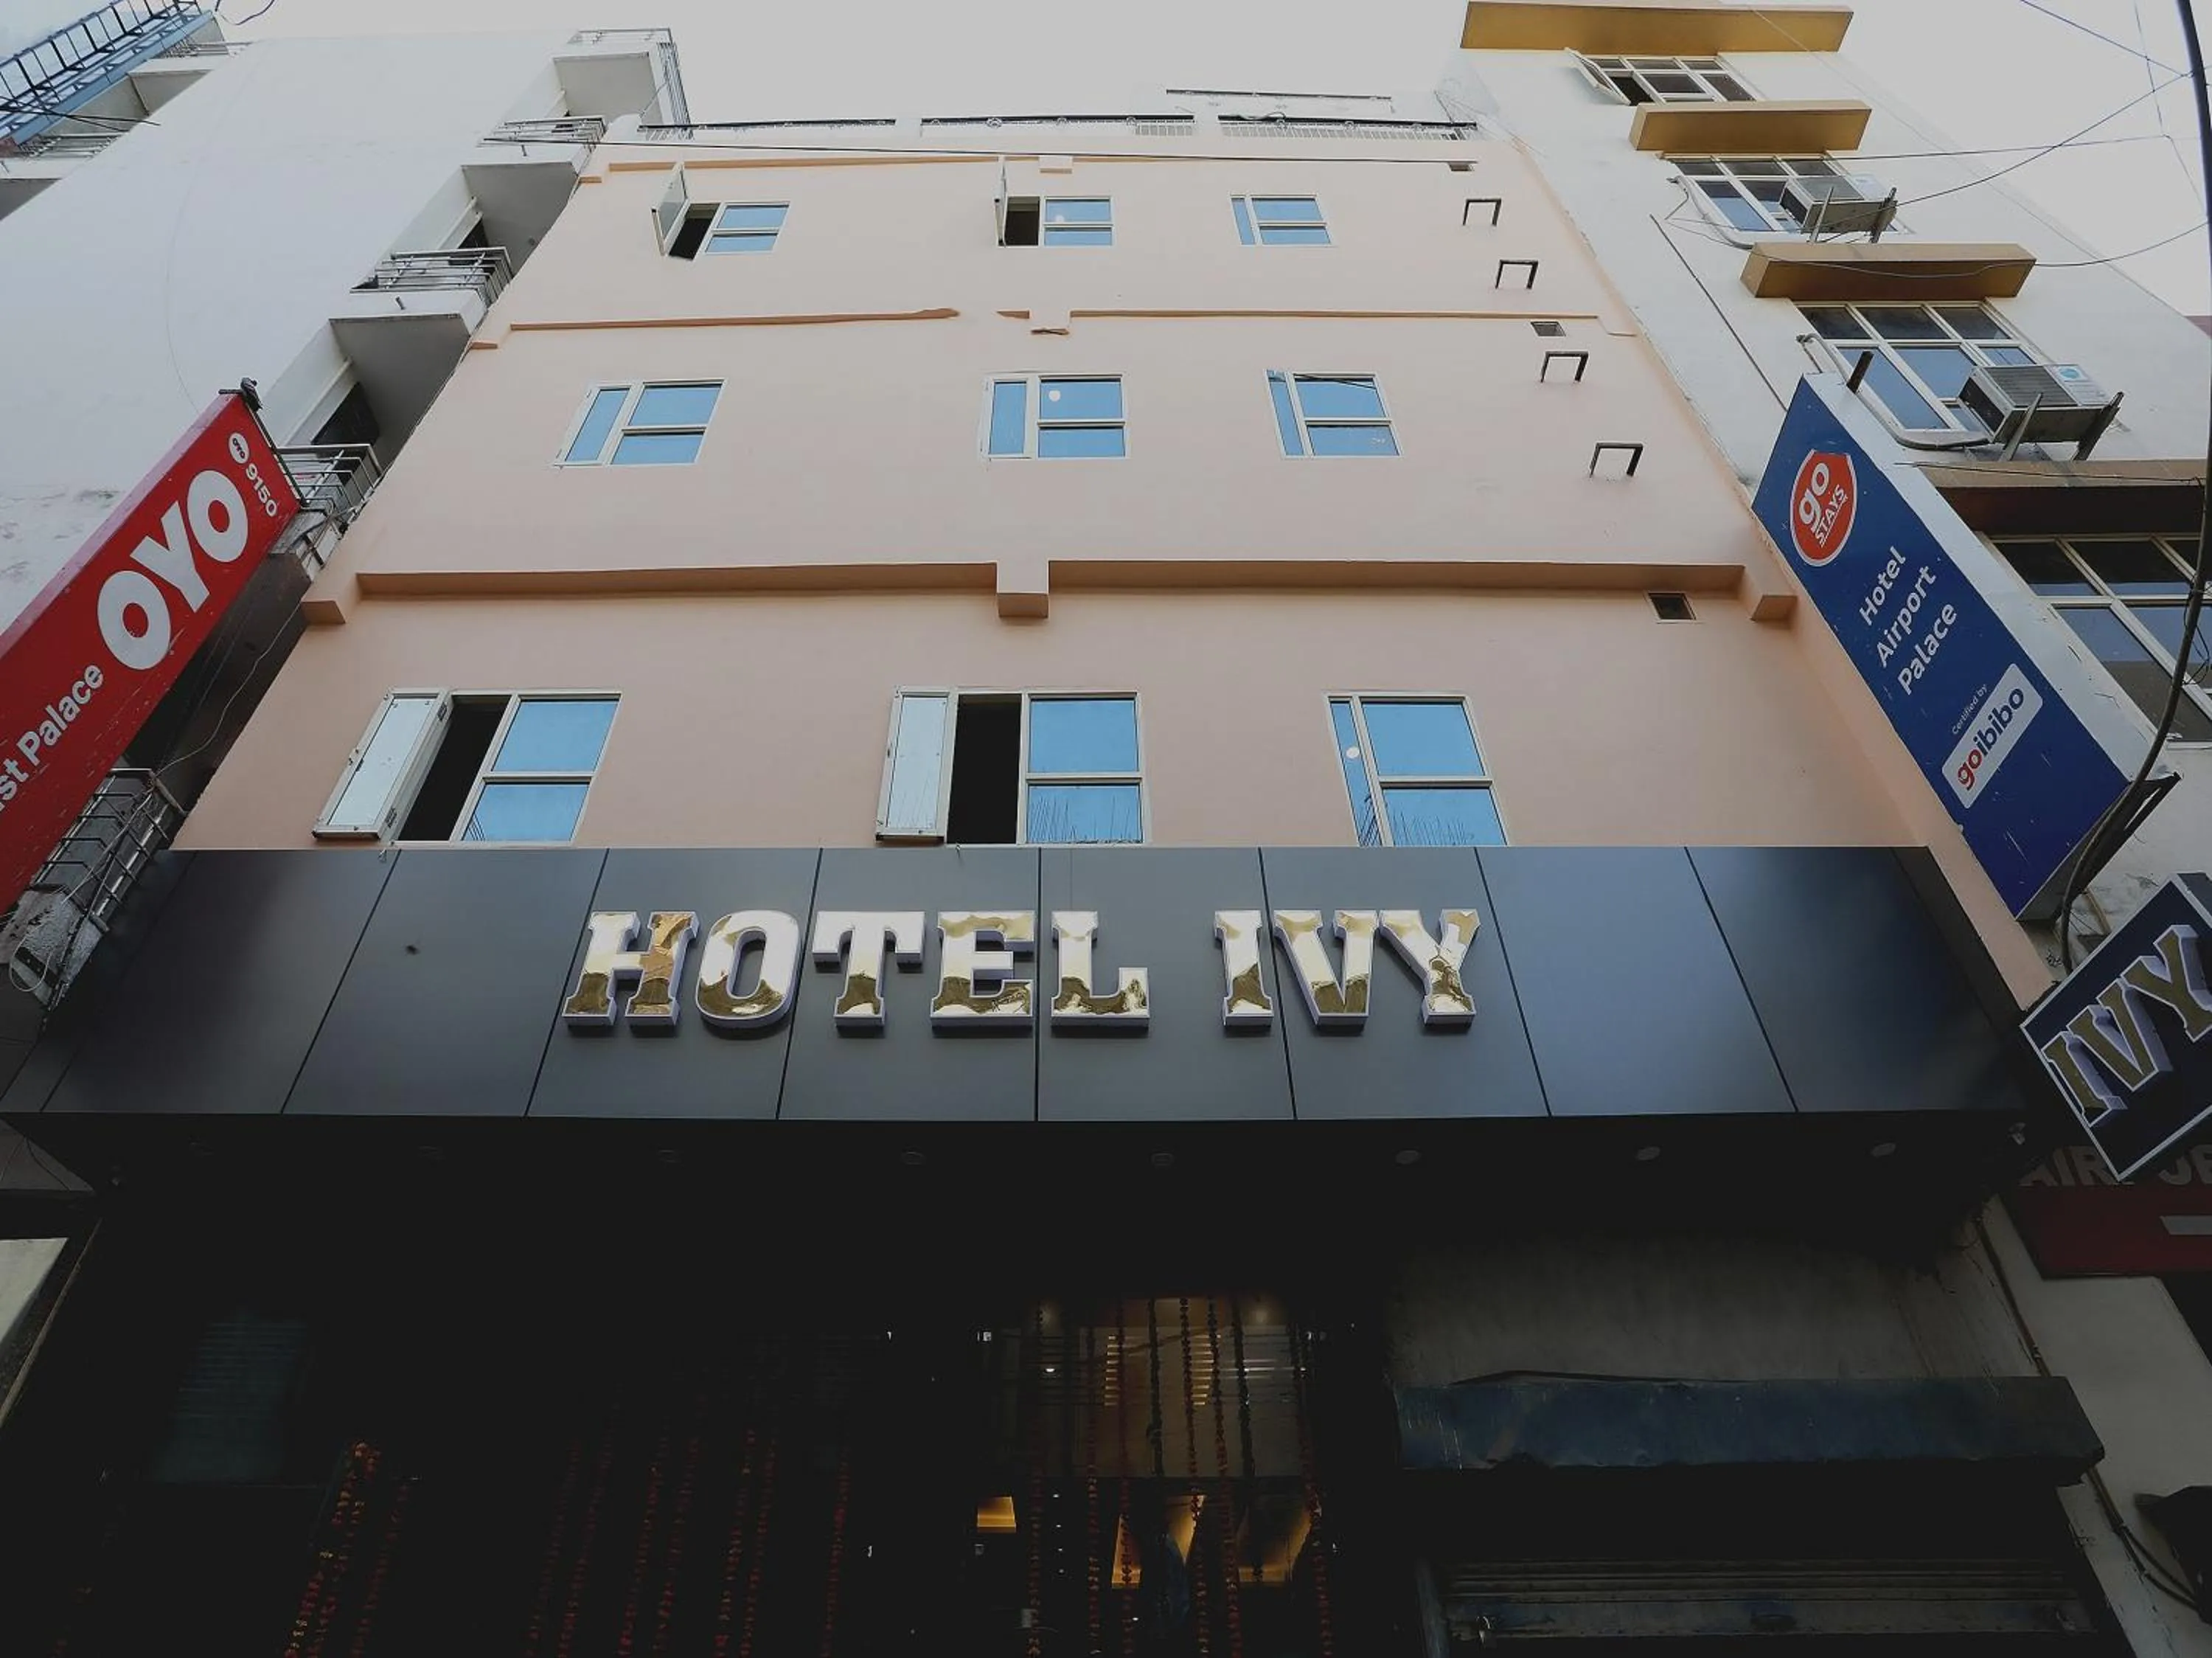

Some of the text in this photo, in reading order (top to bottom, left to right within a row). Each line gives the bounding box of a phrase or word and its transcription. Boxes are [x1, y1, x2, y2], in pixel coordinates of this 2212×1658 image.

[246, 463, 276, 517] 9150
[1798, 462, 1829, 534] go
[1815, 484, 1846, 544] STAYS
[97, 470, 248, 670] OYO
[1859, 545, 1906, 626] Hotel
[1877, 565, 1936, 668] Airport
[1897, 603, 1958, 696] Palace
[0, 665, 104, 811] st Palace
[1952, 684, 1989, 735] Certified by
[1958, 688, 2024, 791] goibibo
[562, 908, 1481, 1028] HOTEL IVY
[2040, 924, 2212, 1128] IVY
